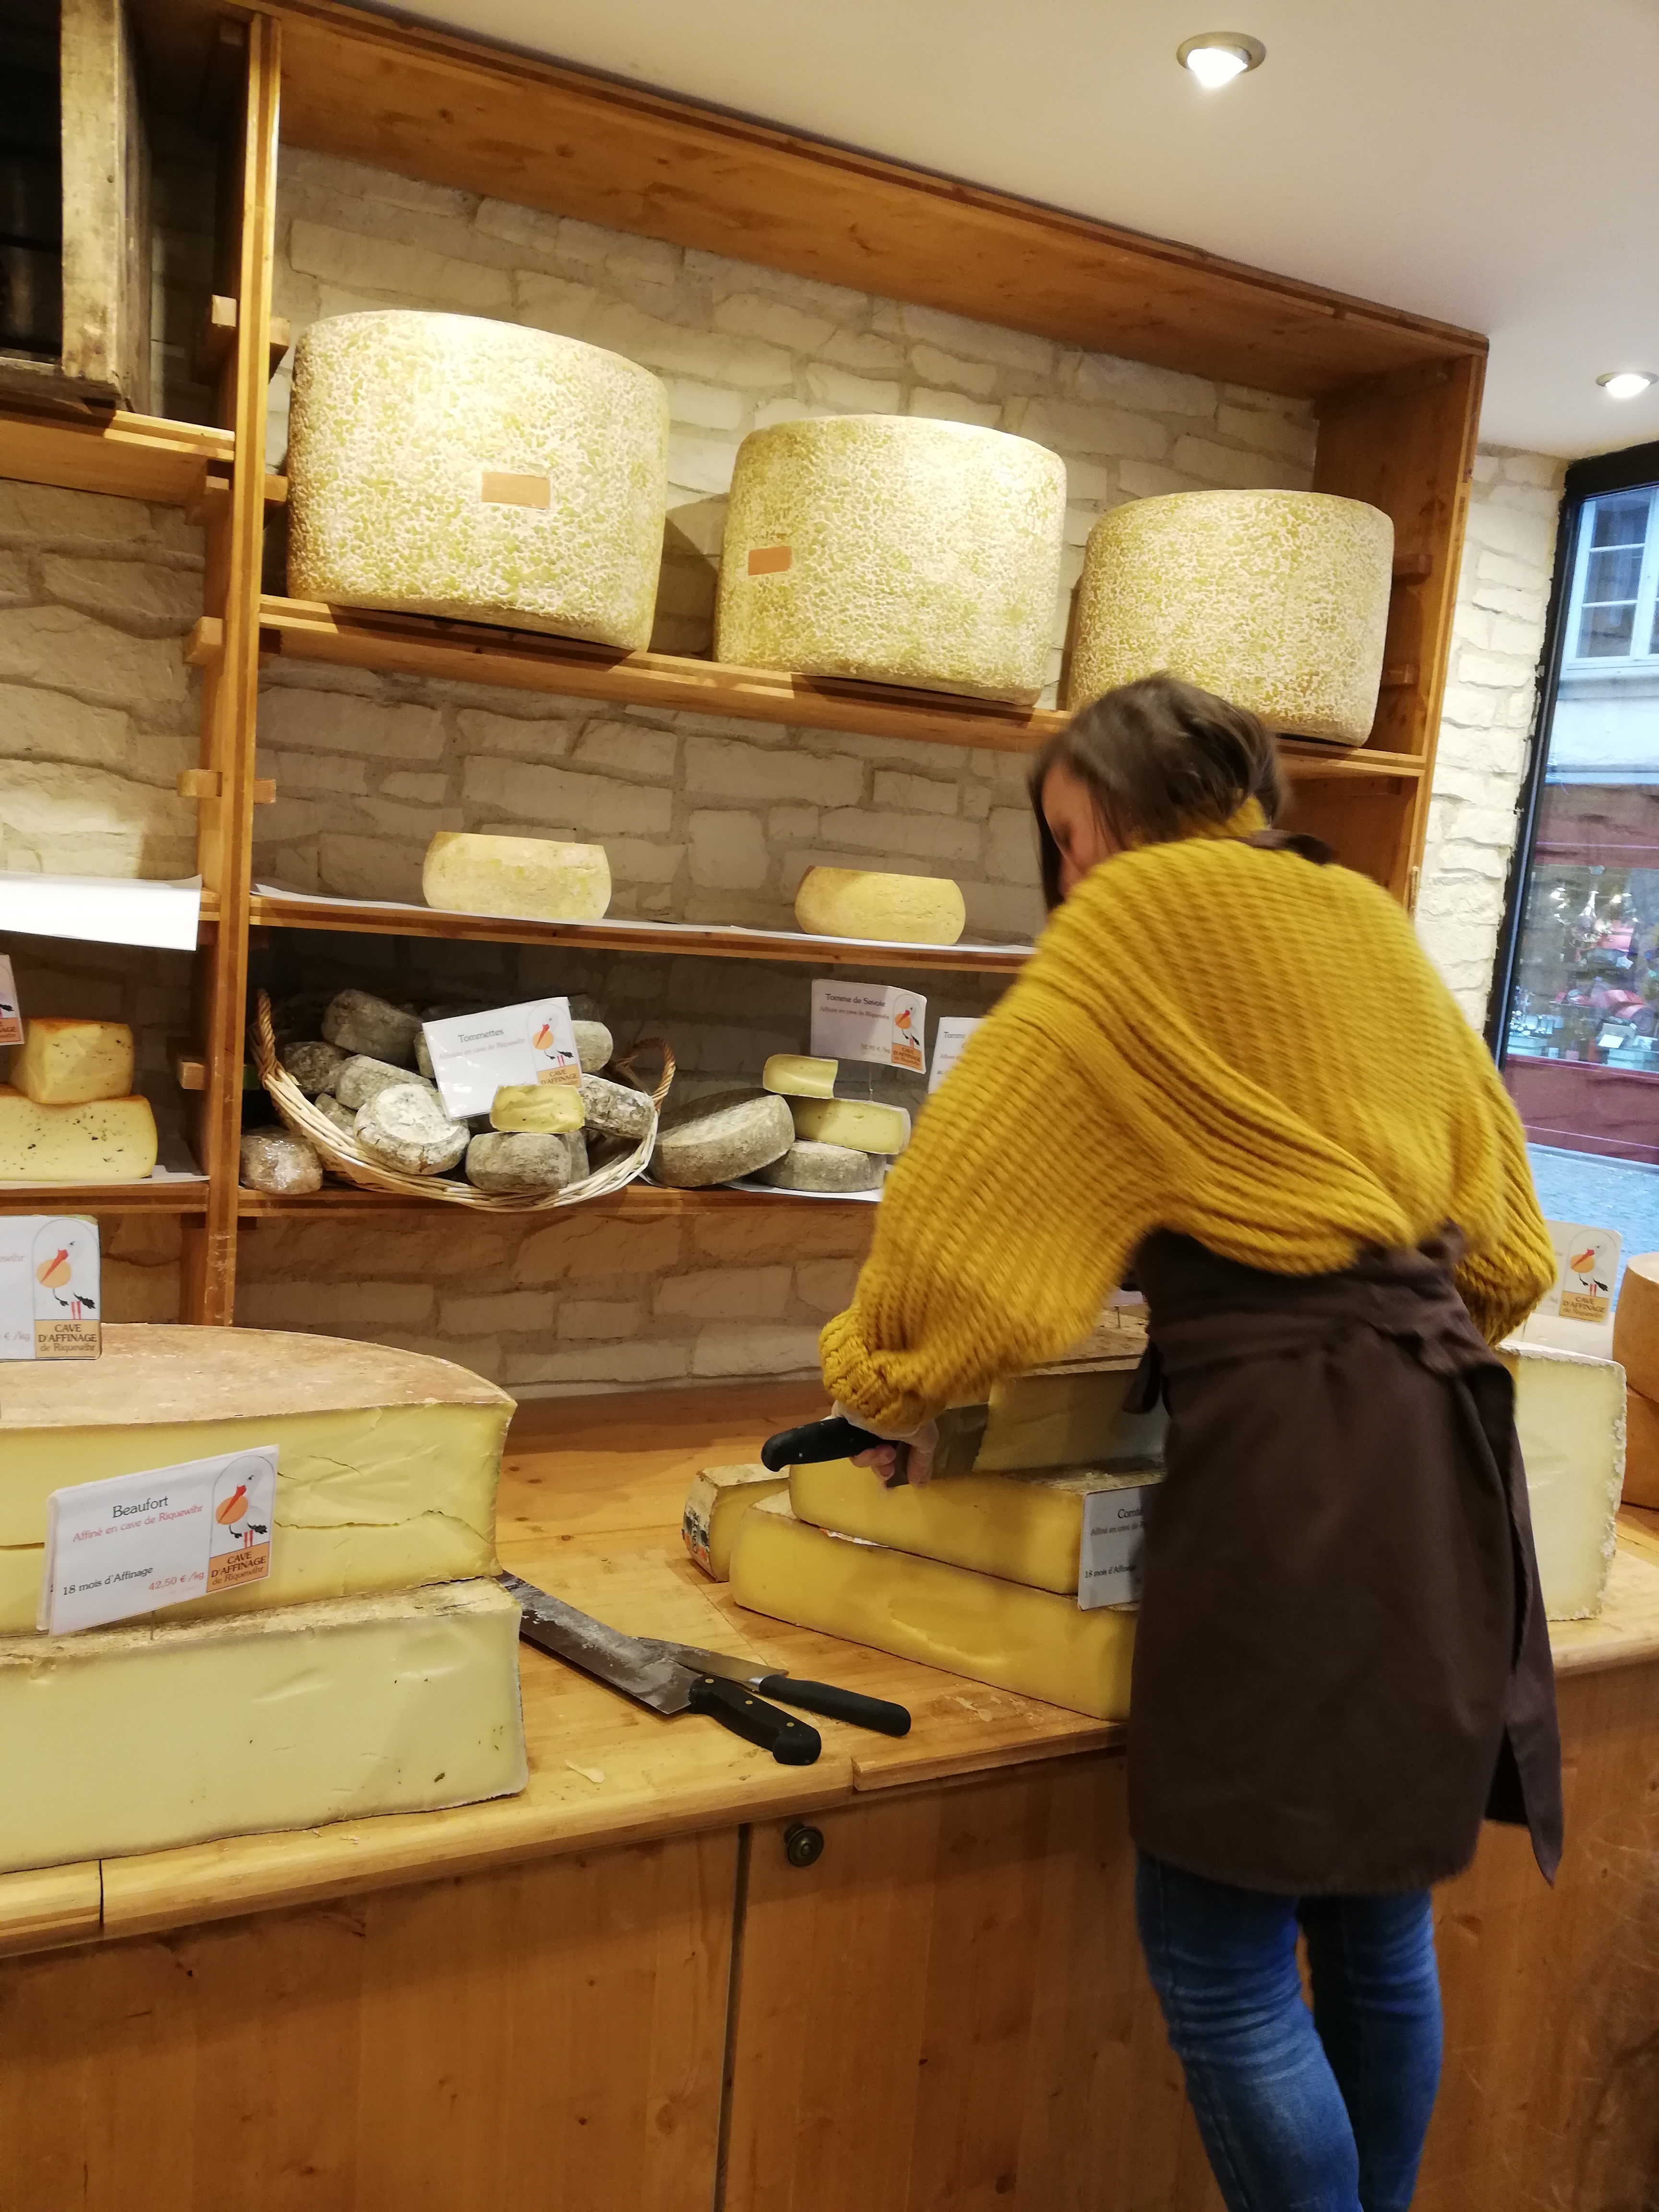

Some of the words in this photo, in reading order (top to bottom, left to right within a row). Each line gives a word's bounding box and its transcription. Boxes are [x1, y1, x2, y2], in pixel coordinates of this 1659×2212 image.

[825, 993, 852, 1002] Tomme
[863, 998, 886, 1007] Savoie
[457, 1029, 504, 1043] Tommettes
[549, 1069, 567, 1077] CAVE
[38, 1334, 97, 1342] D'AFFINAGE
[39, 1343, 51, 1351] de
[112, 1495, 168, 1518] Beaufort
[72, 1527, 102, 1542] Affiné
[105, 1526, 117, 1534] en
[120, 1520, 141, 1530] cave
[144, 1515, 156, 1525] de
[158, 1504, 204, 1522] Riquewihr
[227, 1551, 252, 1564] CAVE
[211, 1555, 266, 1578] D'AFFINAGE
[1084, 1570, 1093, 1578] 18
[63, 1585, 76, 1596] 18
[79, 1579, 102, 1591] mois
[104, 1567, 154, 1585] d'Affinage
[148, 1576, 178, 1591] 42,50
[212, 1577, 222, 1586] de
